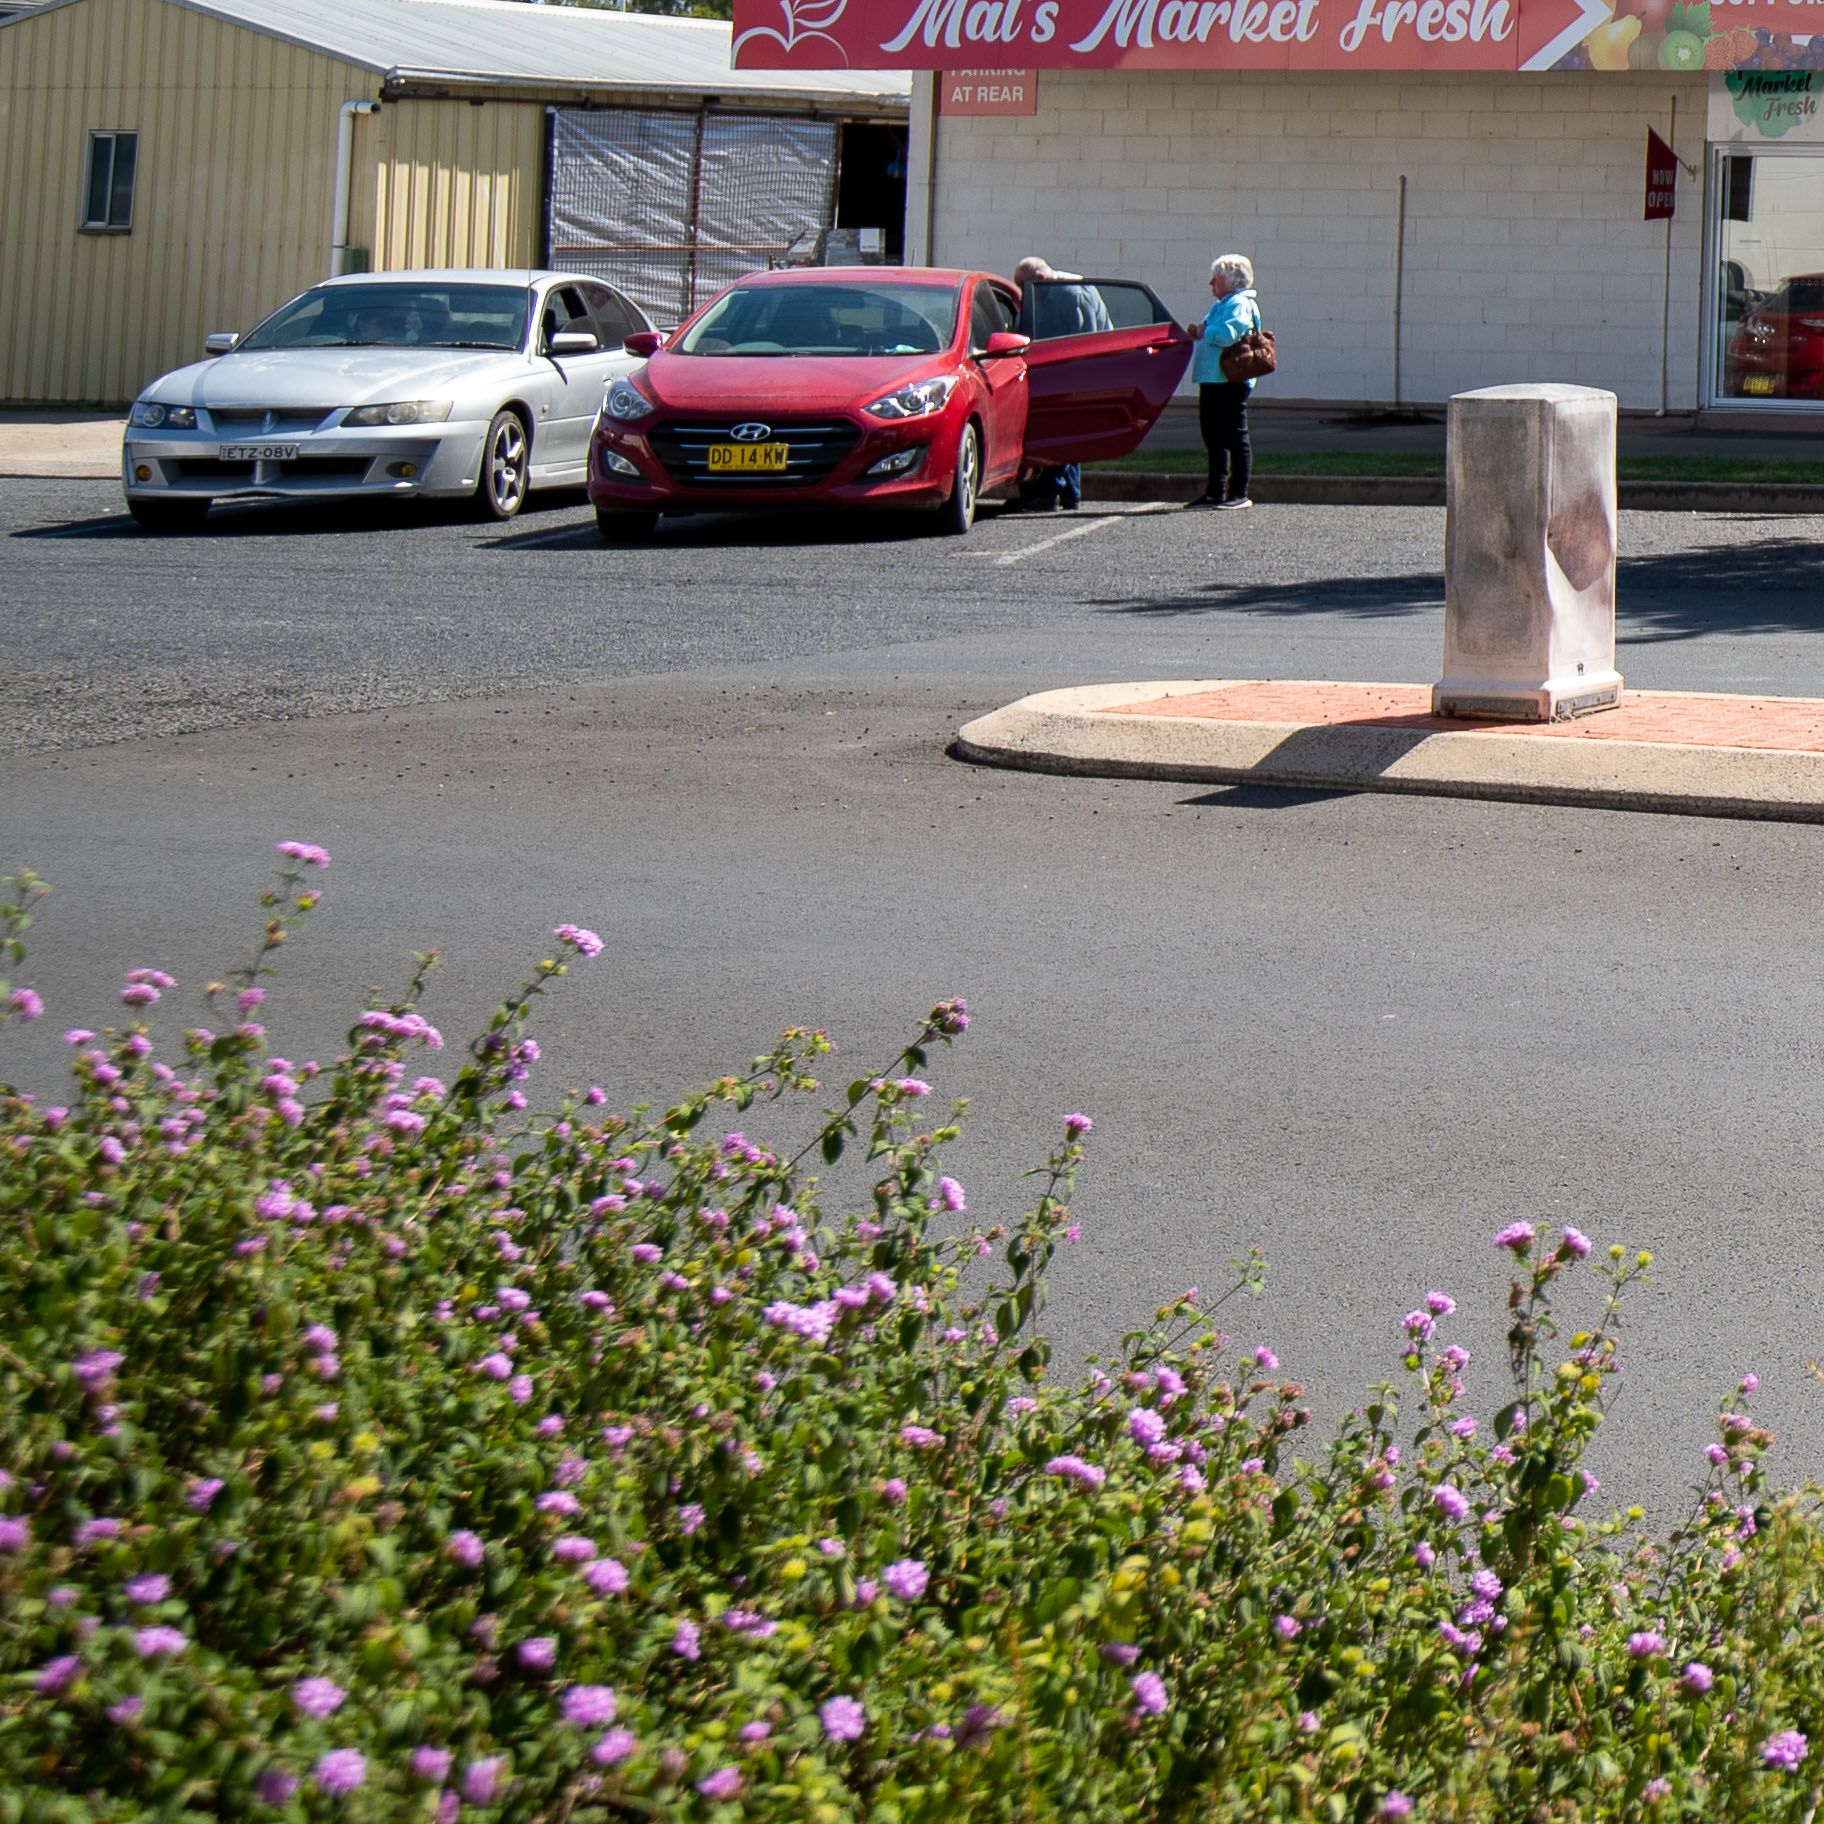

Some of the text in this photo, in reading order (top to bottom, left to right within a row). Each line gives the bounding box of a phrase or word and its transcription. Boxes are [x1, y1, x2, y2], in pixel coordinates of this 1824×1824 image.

[951, 86, 1024, 102] AT REAR
[1735, 73, 1813, 101] Market
[1763, 96, 1817, 121] Fresh
[1652, 169, 1674, 185] NOW
